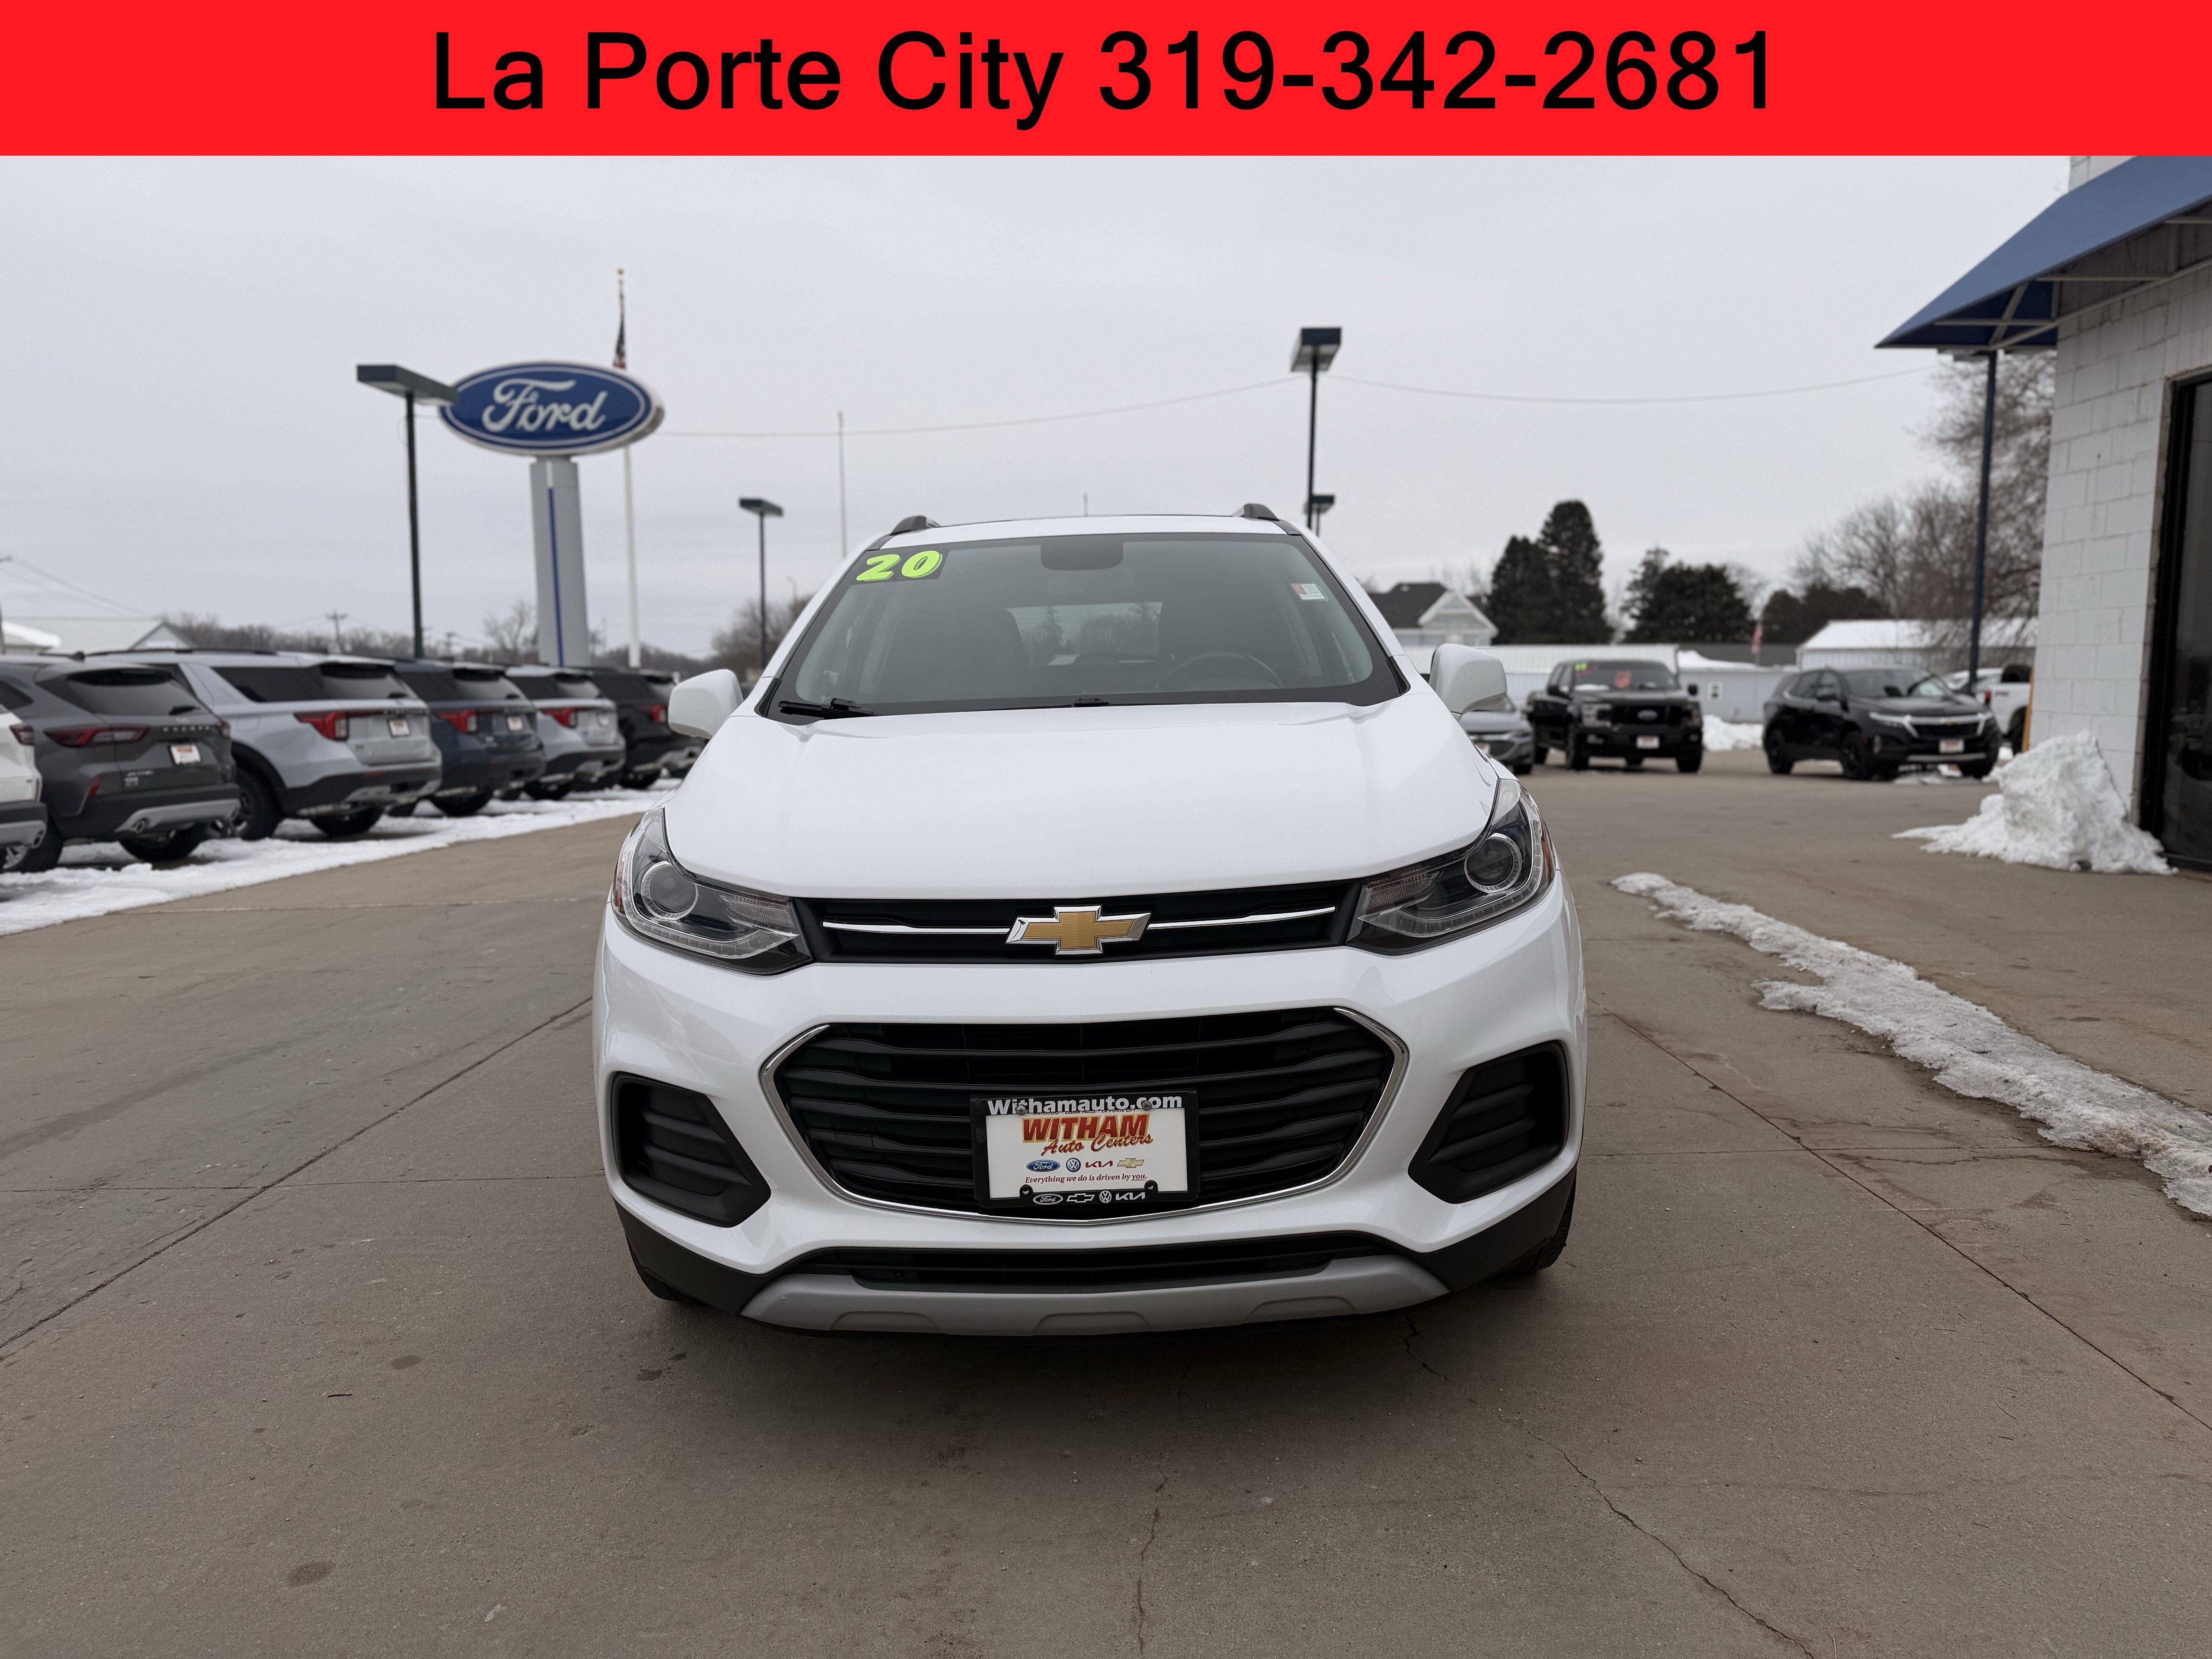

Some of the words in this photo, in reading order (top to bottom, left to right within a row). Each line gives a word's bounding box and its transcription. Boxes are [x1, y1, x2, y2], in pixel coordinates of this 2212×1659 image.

[481, 378, 608, 432] Ford
[856, 550, 943, 582] 20
[1022, 1113, 1150, 1143] WITHAM
[1041, 1138, 1085, 1156] Auto
[1091, 1133, 1154, 1152] Centers
[1025, 1175, 1065, 1184] Everything
[1121, 1173, 1131, 1182] by
